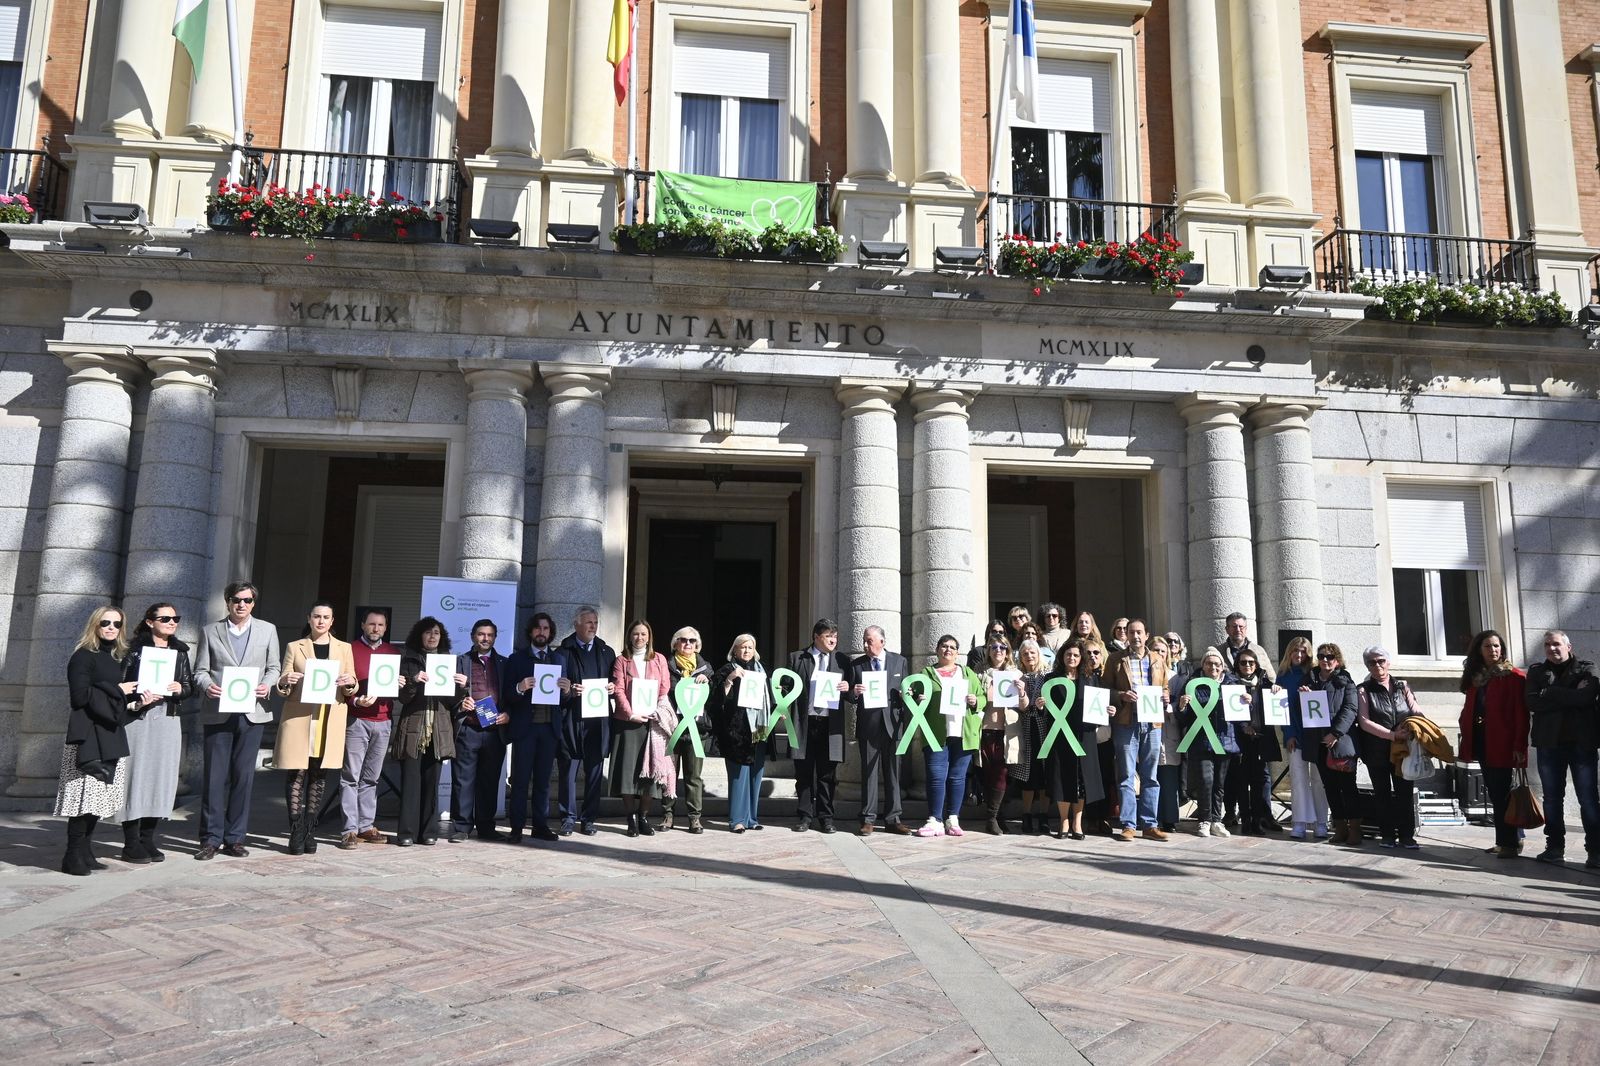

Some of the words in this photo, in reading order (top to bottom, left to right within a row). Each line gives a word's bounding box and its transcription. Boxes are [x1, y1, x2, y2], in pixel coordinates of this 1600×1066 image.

[663, 196, 696, 211] Contra
[698, 204, 708, 213] el
[710, 206, 747, 218] cáncer
[290, 301, 398, 324] MCMXLIX
[569, 310, 884, 347] AYUNTAMIENTO
[1039, 338, 1134, 359] MCMXLIX
